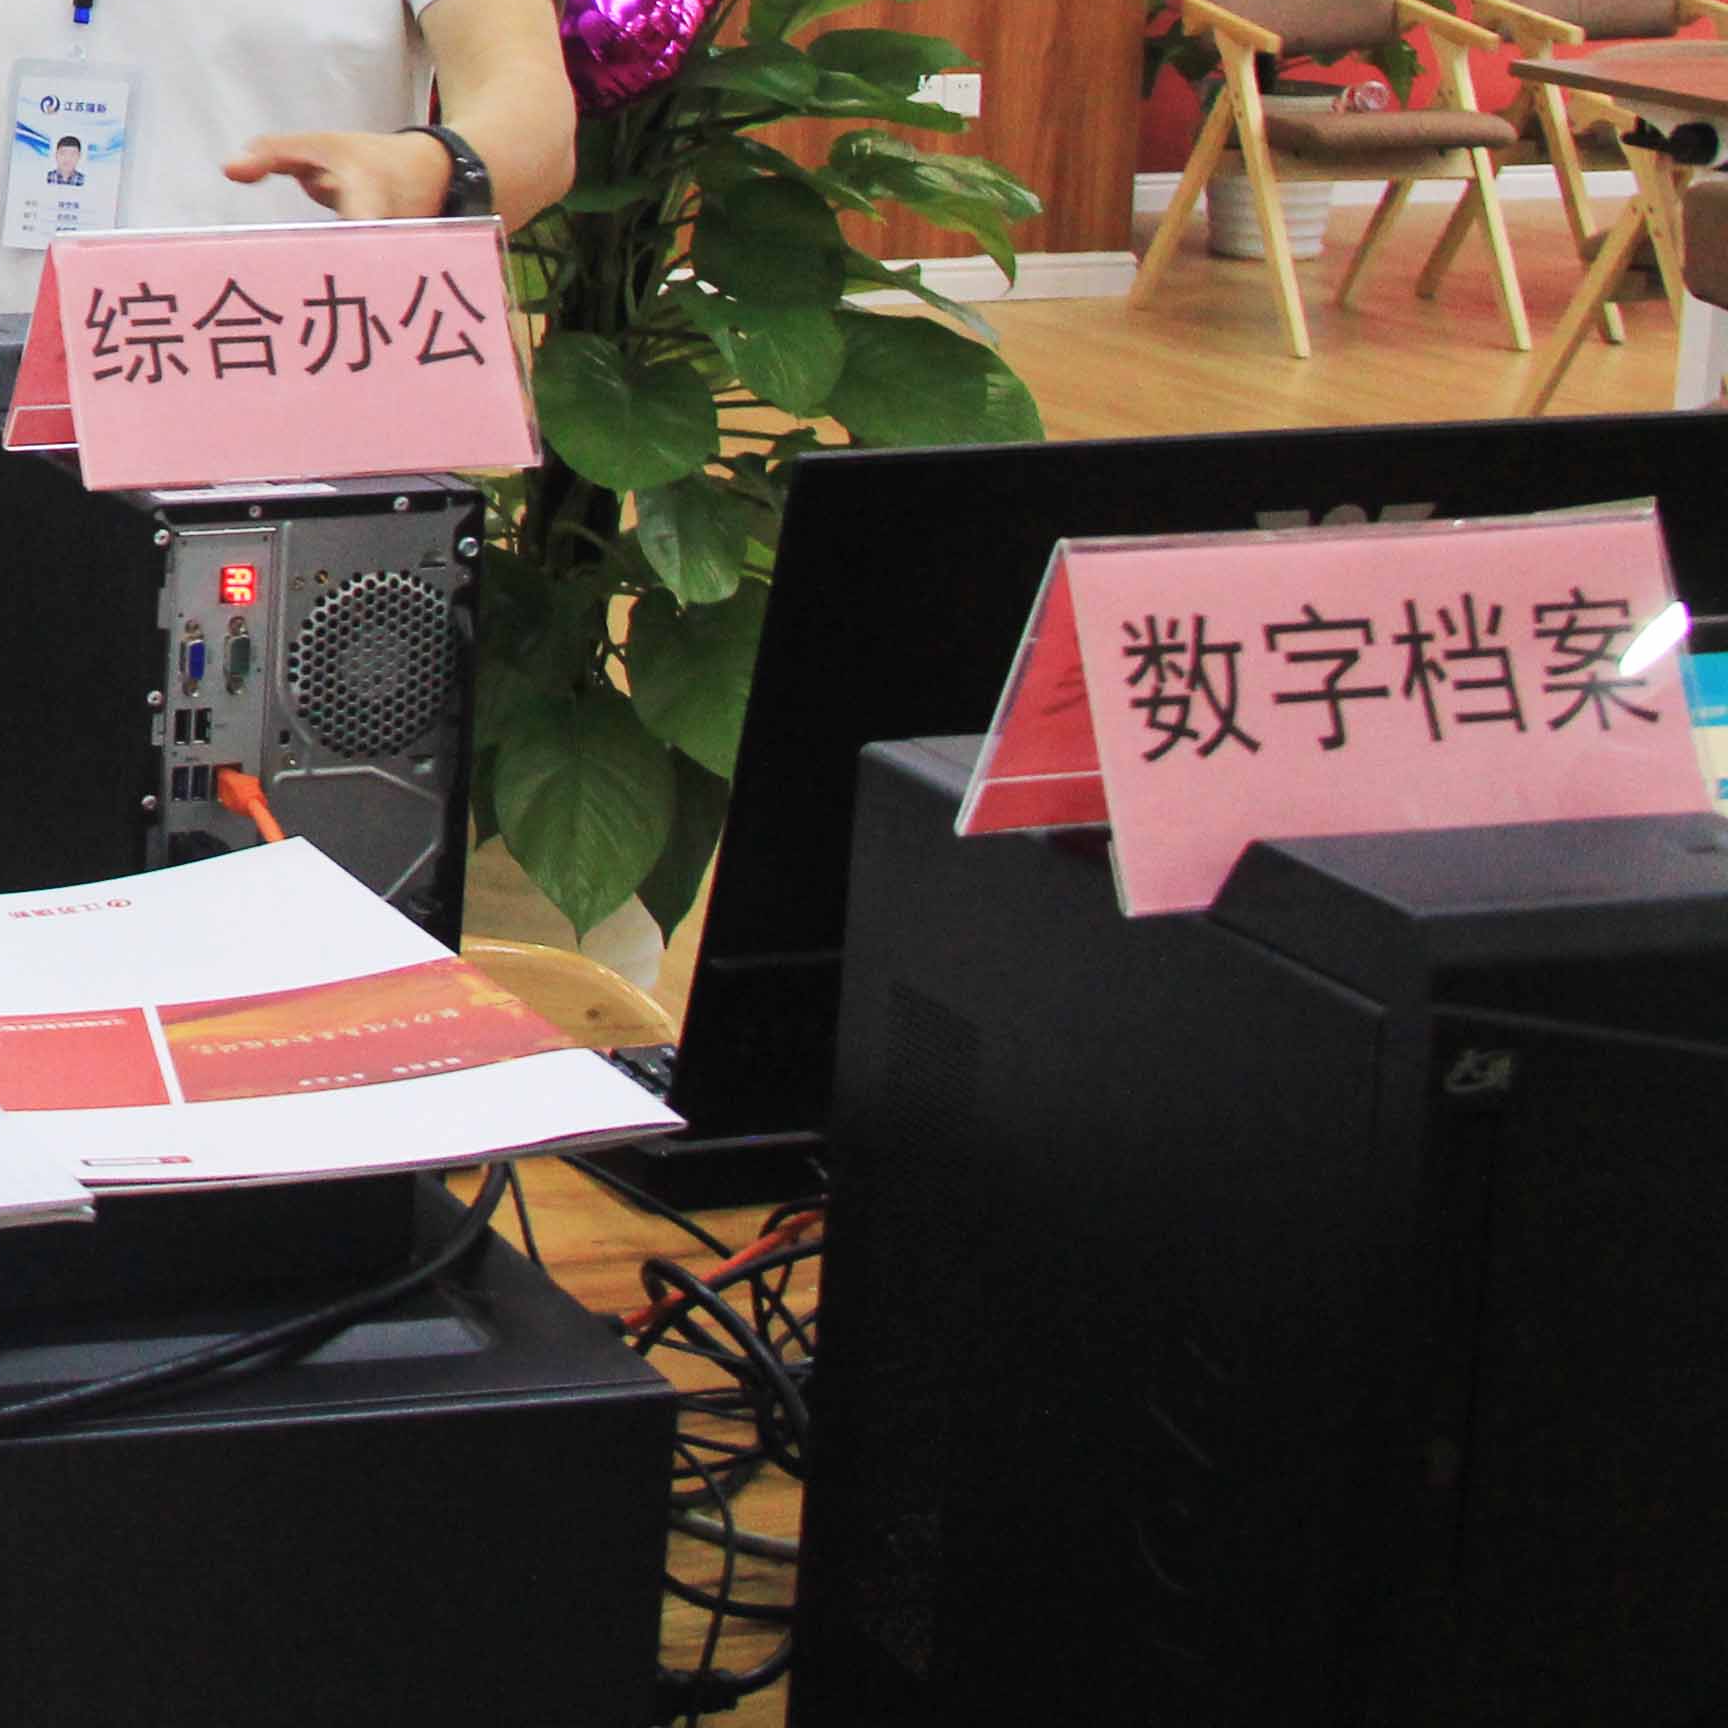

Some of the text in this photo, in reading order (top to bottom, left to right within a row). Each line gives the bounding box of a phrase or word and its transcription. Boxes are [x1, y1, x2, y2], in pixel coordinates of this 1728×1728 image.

[85, 270, 487, 385] 综合办公
[1121, 587, 1661, 763] 数字档案
